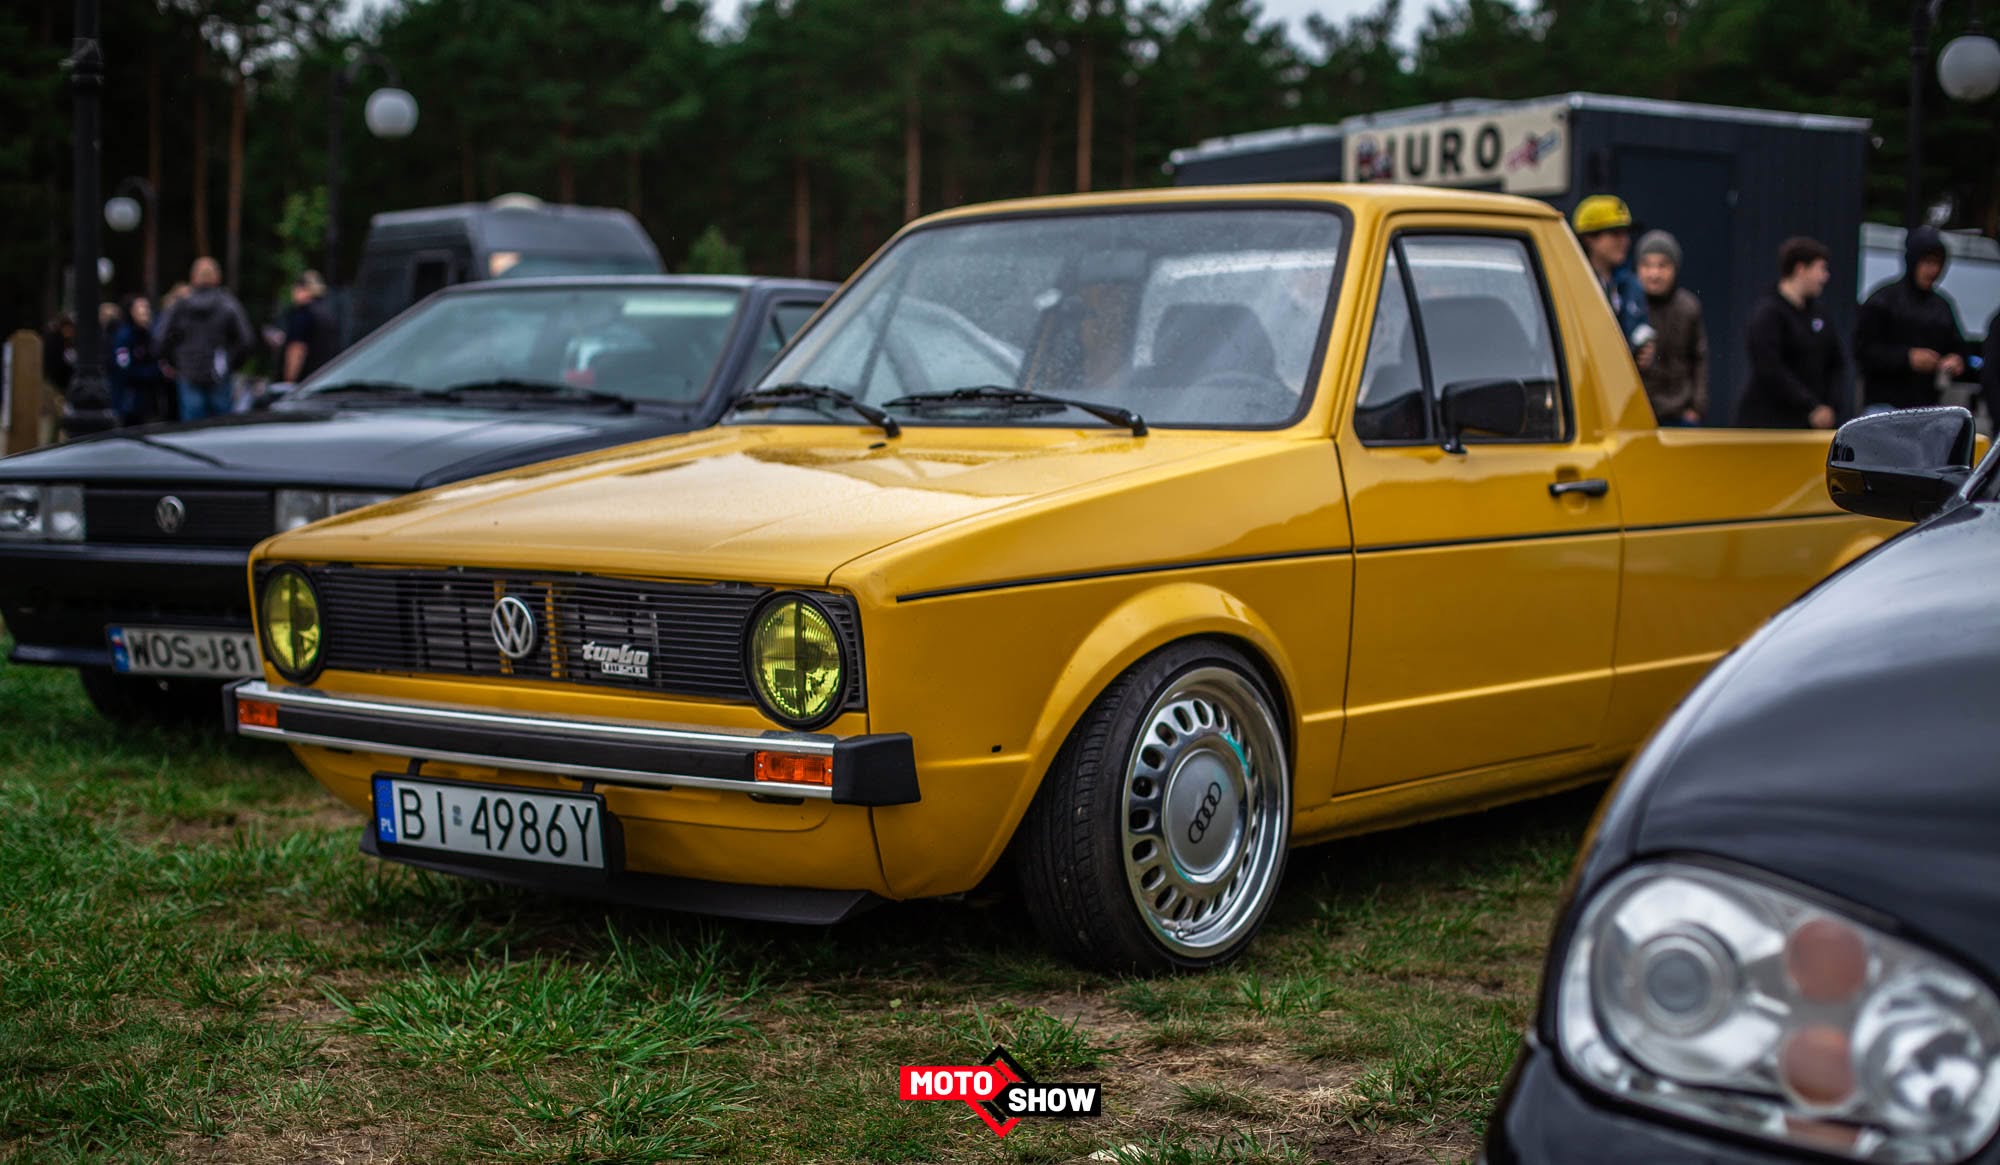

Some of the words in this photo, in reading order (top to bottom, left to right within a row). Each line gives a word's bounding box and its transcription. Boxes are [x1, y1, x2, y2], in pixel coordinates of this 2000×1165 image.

[1357, 122, 1503, 182] URO
[127, 633, 195, 669] WOS
[491, 596, 533, 658] VW
[582, 640, 650, 666] turbo
[380, 818, 394, 833] PL
[398, 787, 446, 845] BI
[470, 796, 593, 862] 4986Y
